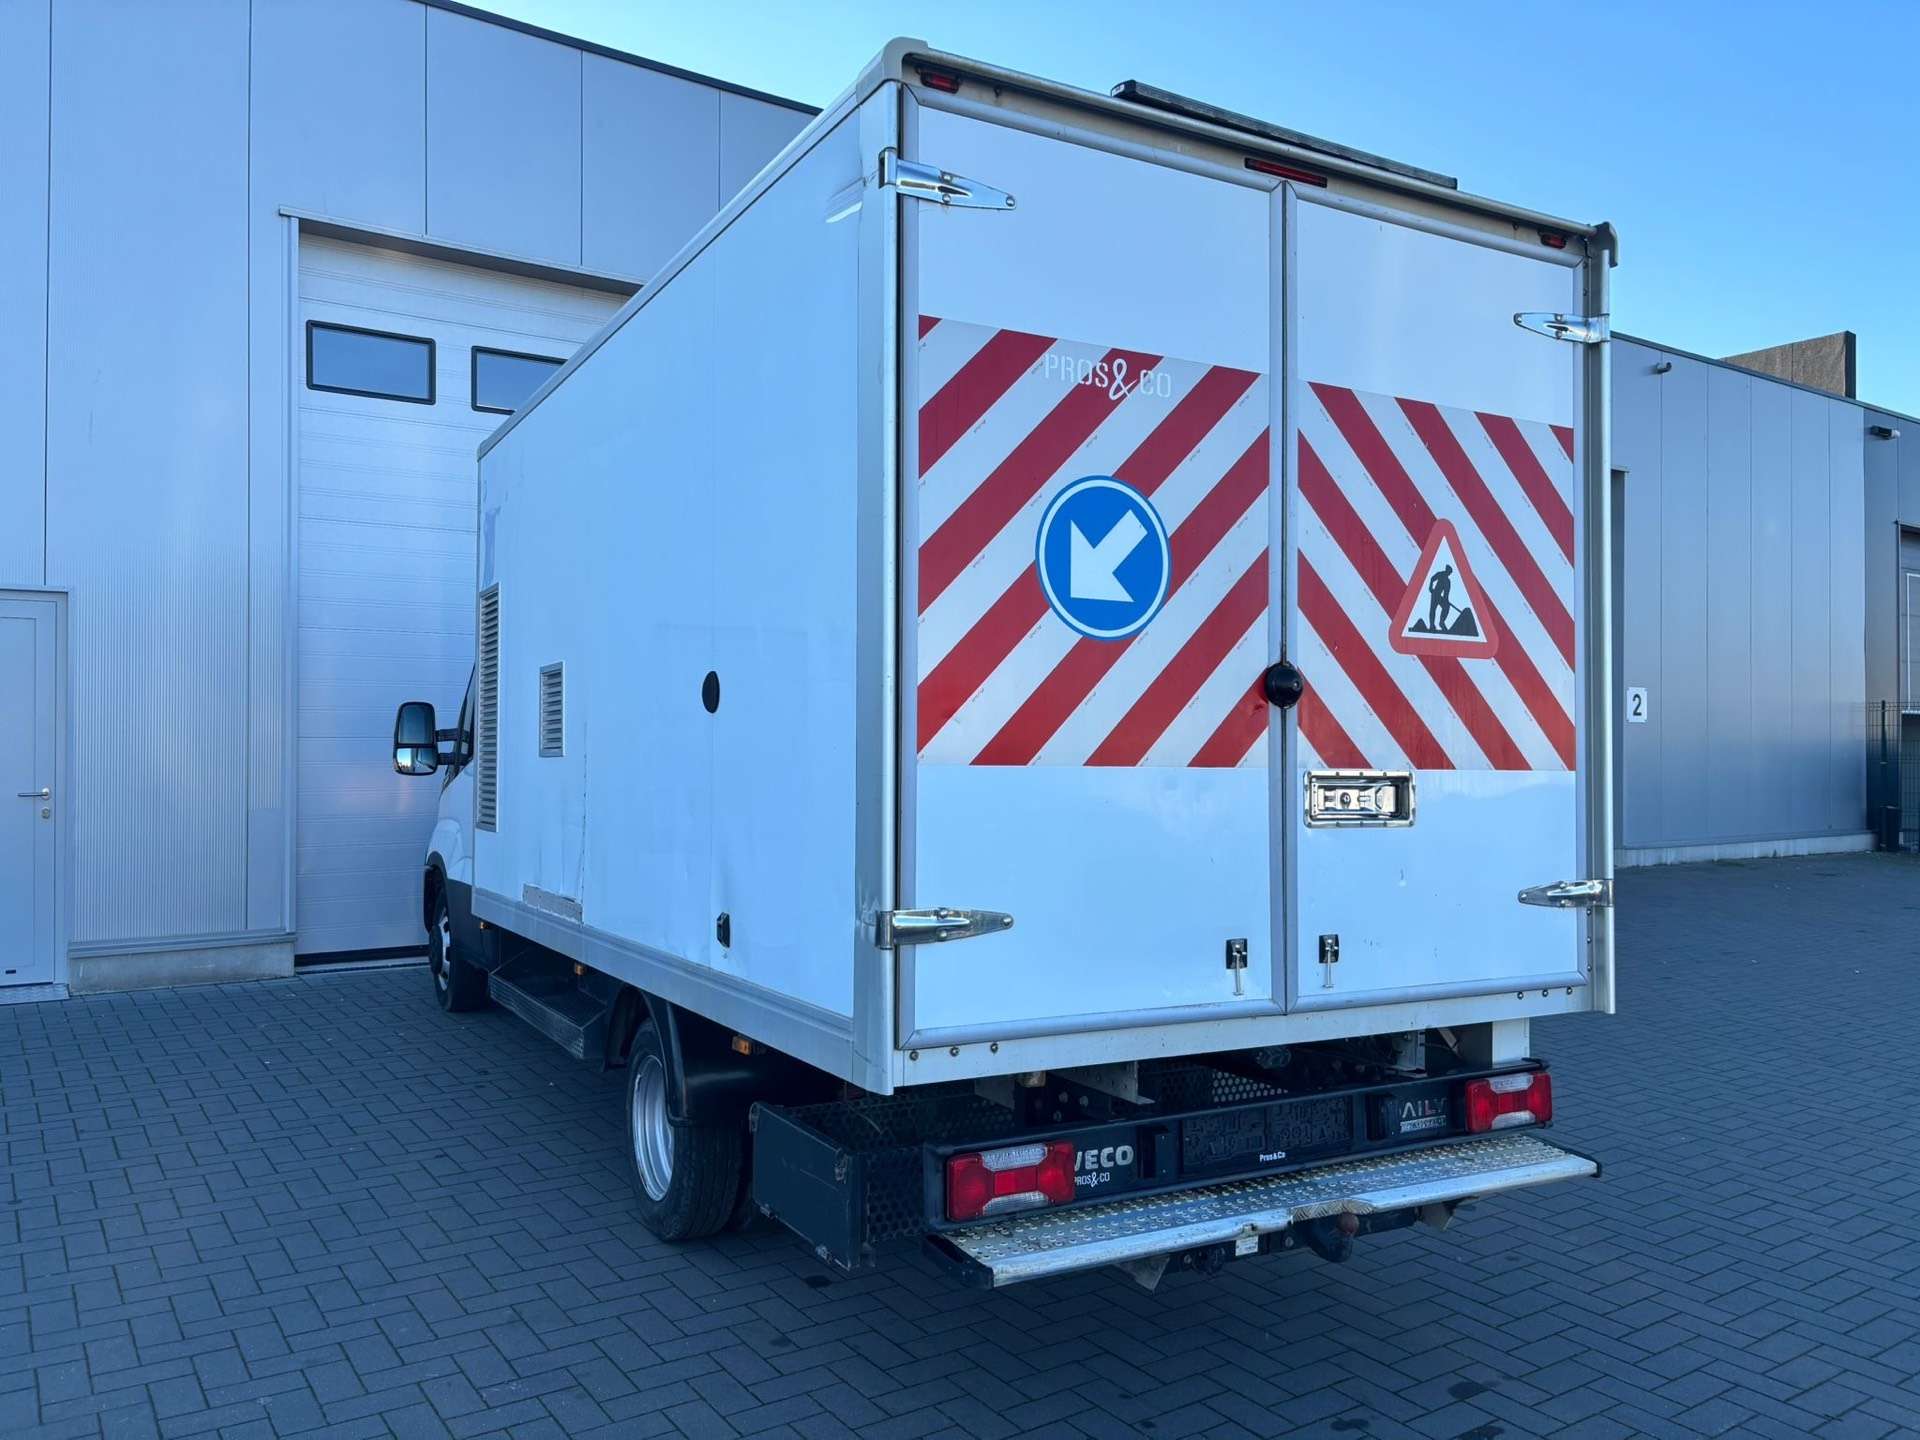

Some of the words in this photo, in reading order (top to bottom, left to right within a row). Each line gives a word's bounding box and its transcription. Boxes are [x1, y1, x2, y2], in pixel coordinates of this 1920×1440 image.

[1632, 693, 1642, 716] 2
[1400, 1098, 1446, 1118] AIL
[1074, 1145, 1134, 1172] VECO
